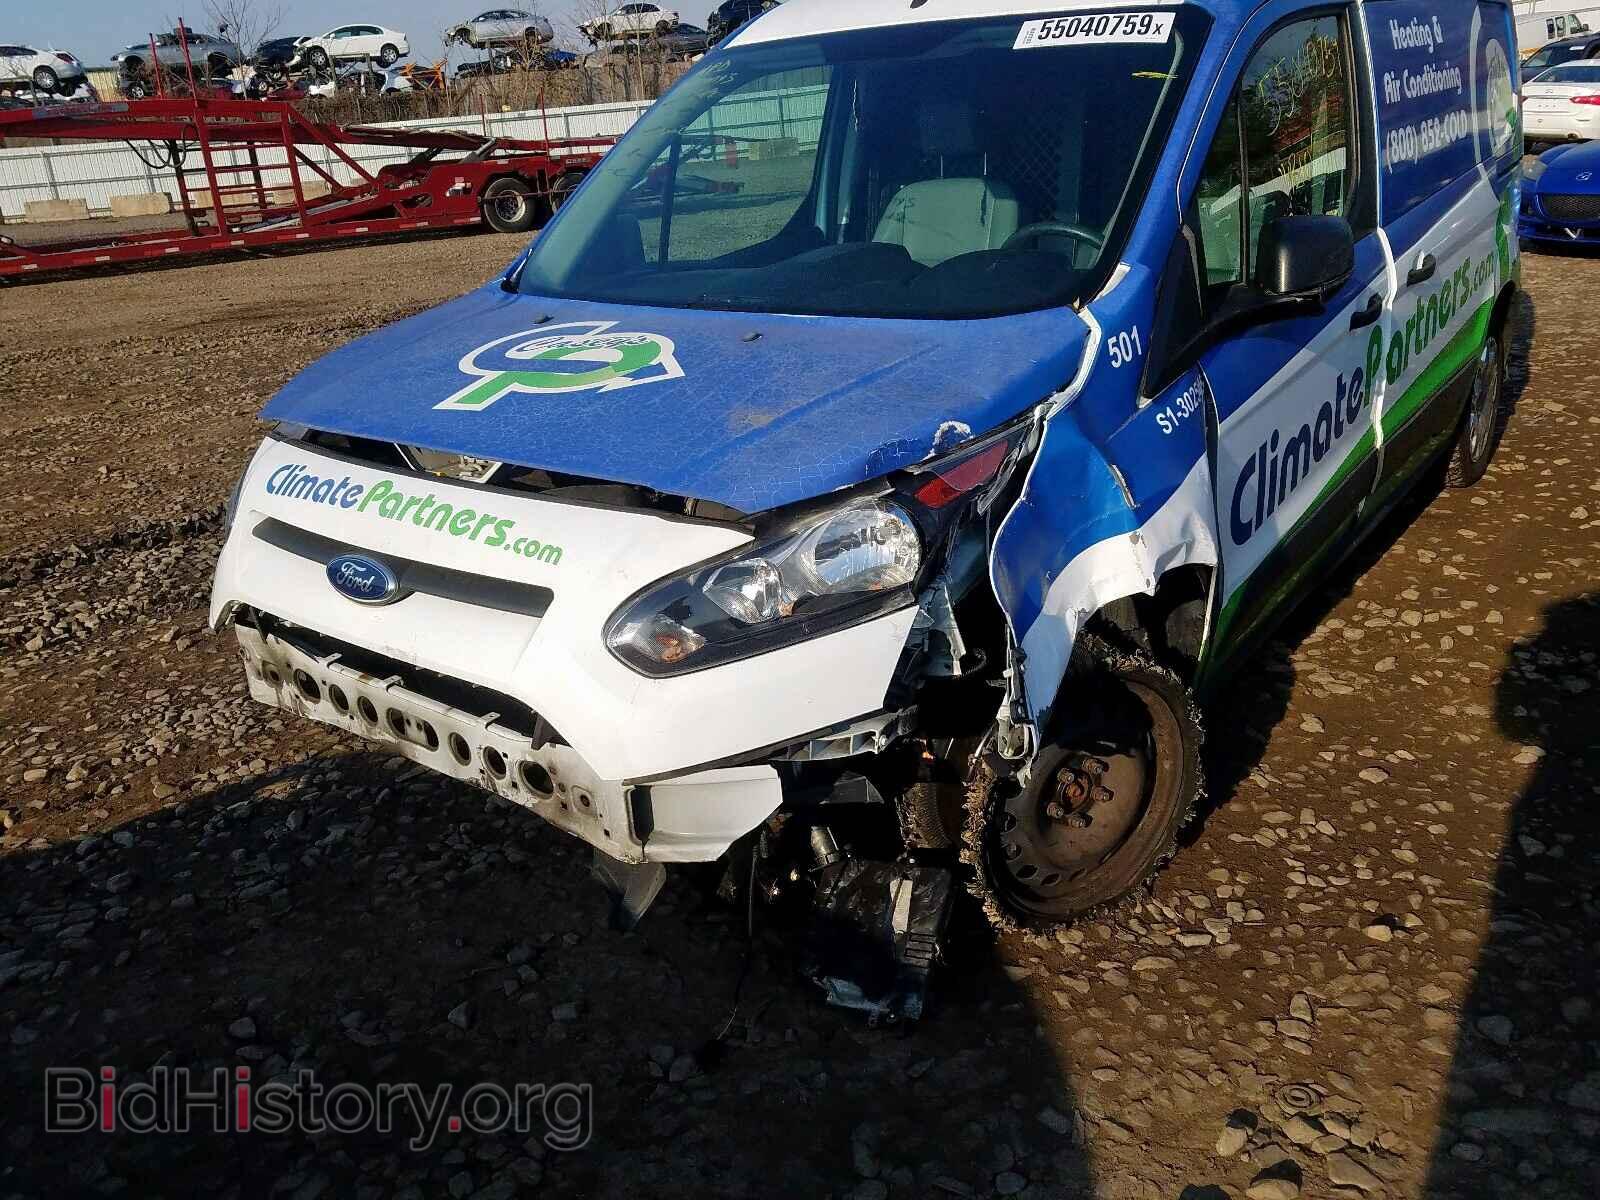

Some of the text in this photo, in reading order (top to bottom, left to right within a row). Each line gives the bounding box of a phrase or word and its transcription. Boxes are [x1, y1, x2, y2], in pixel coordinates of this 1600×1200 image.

[1389, 15, 1444, 54] Heating &
[1383, 71, 1401, 104] Air
[1403, 61, 1463, 99] Conditioning
[1386, 109, 1468, 174] (800) 852-COLD
[1107, 325, 1142, 368] 501
[1230, 251, 1495, 546] ClimatePartners.com
[264, 462, 564, 567] ClimatePartners.com
[334, 561, 374, 593] Ford
